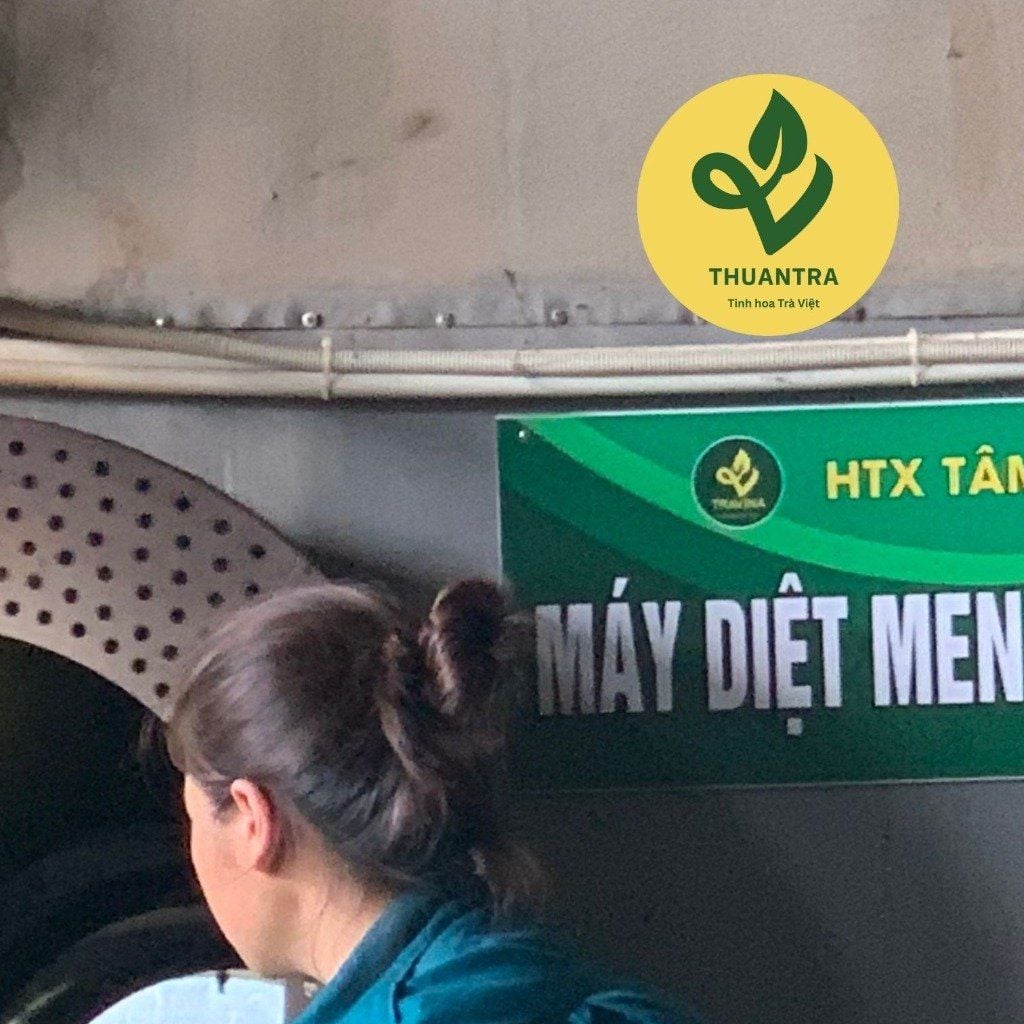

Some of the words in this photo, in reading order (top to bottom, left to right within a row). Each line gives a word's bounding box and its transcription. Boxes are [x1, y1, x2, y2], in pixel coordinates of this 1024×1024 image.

[826, 457, 924, 499] HTX
[535, 576, 682, 716] MÁY
[704, 571, 849, 736] DIỆT
[870, 590, 1024, 707] MEN
